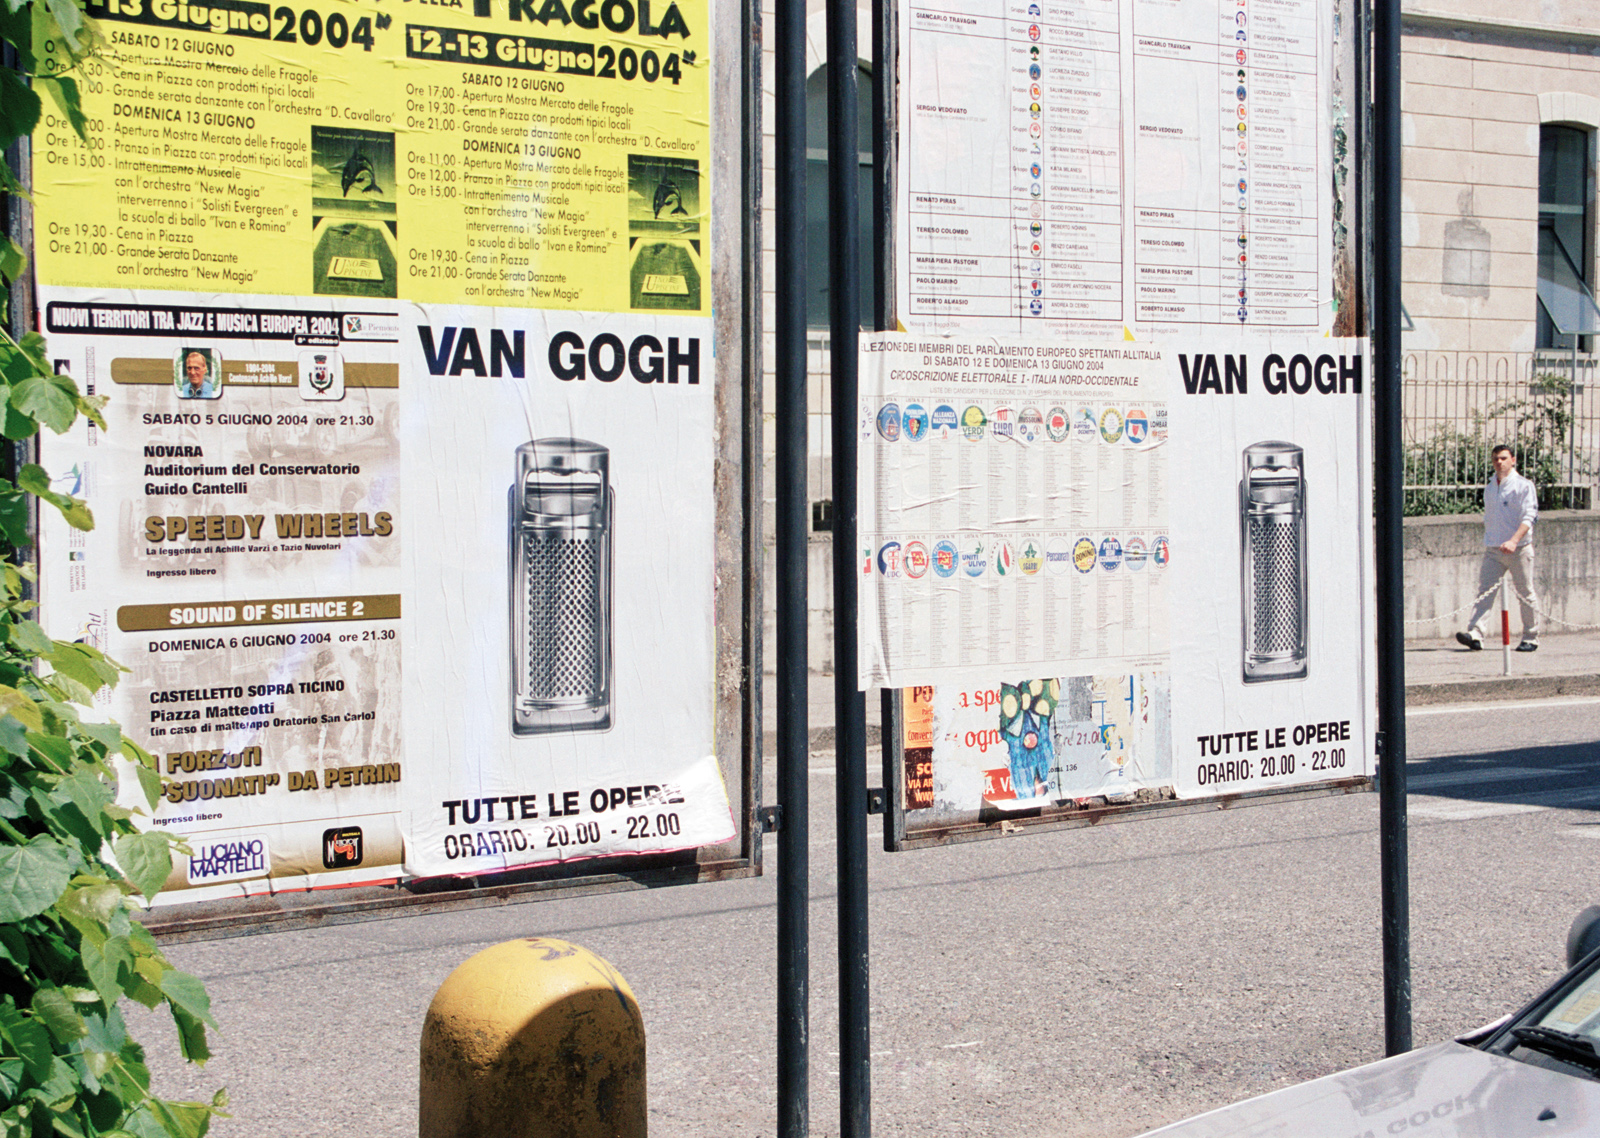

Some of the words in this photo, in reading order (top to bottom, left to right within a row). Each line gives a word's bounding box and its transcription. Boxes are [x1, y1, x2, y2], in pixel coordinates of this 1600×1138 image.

[111, 31, 160, 48] SABATO
[165, 37, 178, 50] 12
[183, 39, 234, 57] GIUGNO
[409, 28, 488, 59] 12-13
[496, 38, 593, 73] Giugno
[462, 72, 502, 87] SABATO
[507, 77, 518, 89] 12
[521, 78, 565, 93] GIUGNO
[406, 83, 424, 96] Ore
[428, 85, 454, 100] 17,00
[463, 89, 502, 104] Apertura
[506, 93, 537, 107] Mostra
[540, 96, 575, 110] Mercato
[578, 99, 599, 112] delle
[601, 101, 634, 117] Fragole
[916, 104, 937, 112] SERGIO
[938, 106, 968, 115] VEDOVATO
[113, 103, 181, 123] DOMENICA
[187, 110, 200, 124] 13
[204, 113, 254, 129] GIUGNO
[1139, 125, 1158, 133] SERGIO
[1159, 127, 1183, 135] VEDOVATO
[463, 139, 520, 155] DOMENICA
[524, 144, 535, 156] 13
[538, 146, 581, 160] GIUGNO
[464, 188, 529, 203] Intrattenimento
[532, 193, 569, 205] Musicale
[499, 270, 525, 282] Serata
[528, 271, 566, 284] Danzante
[52, 307, 89, 327] NUOVI
[91, 309, 150, 329] TERRITORI
[152, 311, 174, 330] TRA
[177, 312, 204, 331] JAZZ
[206, 313, 213, 331] E
[217, 313, 258, 333] MUSICA
[260, 315, 308, 335] EUROPEA
[311, 317, 339, 335] 2004
[417, 325, 525, 378] VAN
[548, 331, 700, 385] GOGH
[919, 343, 954, 354] MEMBRI
[957, 344, 974, 354] DEL
[976, 345, 1034, 356] PARLAMENTO
[1037, 347, 1076, 358] EUROPEO
[1079, 349, 1120, 359] SPETTANTI
[935, 356, 969, 367] SABATO
[973, 357, 982, 367] 12
[993, 358, 1038, 369] DOMENICA
[1041, 360, 1049, 369] 13
[1052, 360, 1084, 370] GIUGNO
[1086, 361, 1103, 370] 2004
[961, 372, 1017, 384] ELETTORALE
[1032, 374, 1057, 384] ITALIA
[1059, 375, 1139, 386] NORD-OCCIDENTALE
[1178, 354, 1247, 395] VAN
[1262, 354, 1362, 395] GOGH
[143, 413, 201, 425] SABATO
[206, 413, 213, 425] 5
[217, 414, 272, 425] GIUGNO
[277, 415, 308, 426] 2004
[316, 416, 336, 426] ore
[340, 415, 374, 426] 21.30
[963, 427, 984, 435] VERDI
[144, 446, 203, 458] NOVARA
[144, 464, 227, 476] Auditorium
[232, 464, 254, 475] del
[259, 463, 360, 475] Conservatorio
[144, 483, 187, 495] Guido
[192, 482, 247, 494] Cantelli
[145, 514, 264, 542] SPEEDY
[275, 511, 392, 539] WHEELS
[146, 548, 156, 556] La
[159, 546, 202, 558] leggenda
[204, 546, 213, 554] di
[215, 544, 245, 554] Achille
[248, 544, 270, 553] Varzi
[281, 543, 302, 553] Tazio
[305, 542, 341, 552] Nuvolari
[147, 569, 187, 580] Ingresso
[190, 568, 216, 576] libero
[170, 606, 236, 625] SOUND
[242, 604, 266, 621] OF
[271, 602, 347, 621] SILENCE
[353, 601, 364, 616] 2
[149, 637, 225, 653] DOMENICA
[229, 638, 238, 649] 6
[242, 634, 296, 649] GIUGNO
[300, 633, 331, 645] 2004
[339, 634, 358, 643] ore
[361, 630, 395, 643] 21.30
[150, 686, 243, 704] CASTELLETTO
[248, 683, 295, 698] SOPRA
[298, 680, 345, 694] TICINO
[150, 709, 200, 723] Piazza
[206, 703, 275, 720] Matteotti
[170, 727, 198, 736] caso
[202, 724, 212, 734] di
[272, 716, 318, 729] Oratorio
[321, 714, 340, 724] San
[1197, 731, 1258, 757] TUTTE
[1265, 728, 1286, 749] LE
[1293, 721, 1350, 746] OPERE
[1198, 759, 1254, 786] ORARIO:
[1261, 754, 1295, 778] 20.00
[1312, 748, 1345, 771] 22.00
[288, 770, 319, 792] DA
[153, 814, 193, 826] Ingresso
[196, 811, 222, 822] libero
[442, 794, 539, 826] TUTTE
[548, 790, 580, 818] LE
[444, 827, 535, 860] ORARIO:
[544, 821, 600, 848] 20.00
[626, 813, 681, 840] 22.00
[190, 839, 263, 864] LUCIANO
[190, 855, 264, 880] MARTELLI
